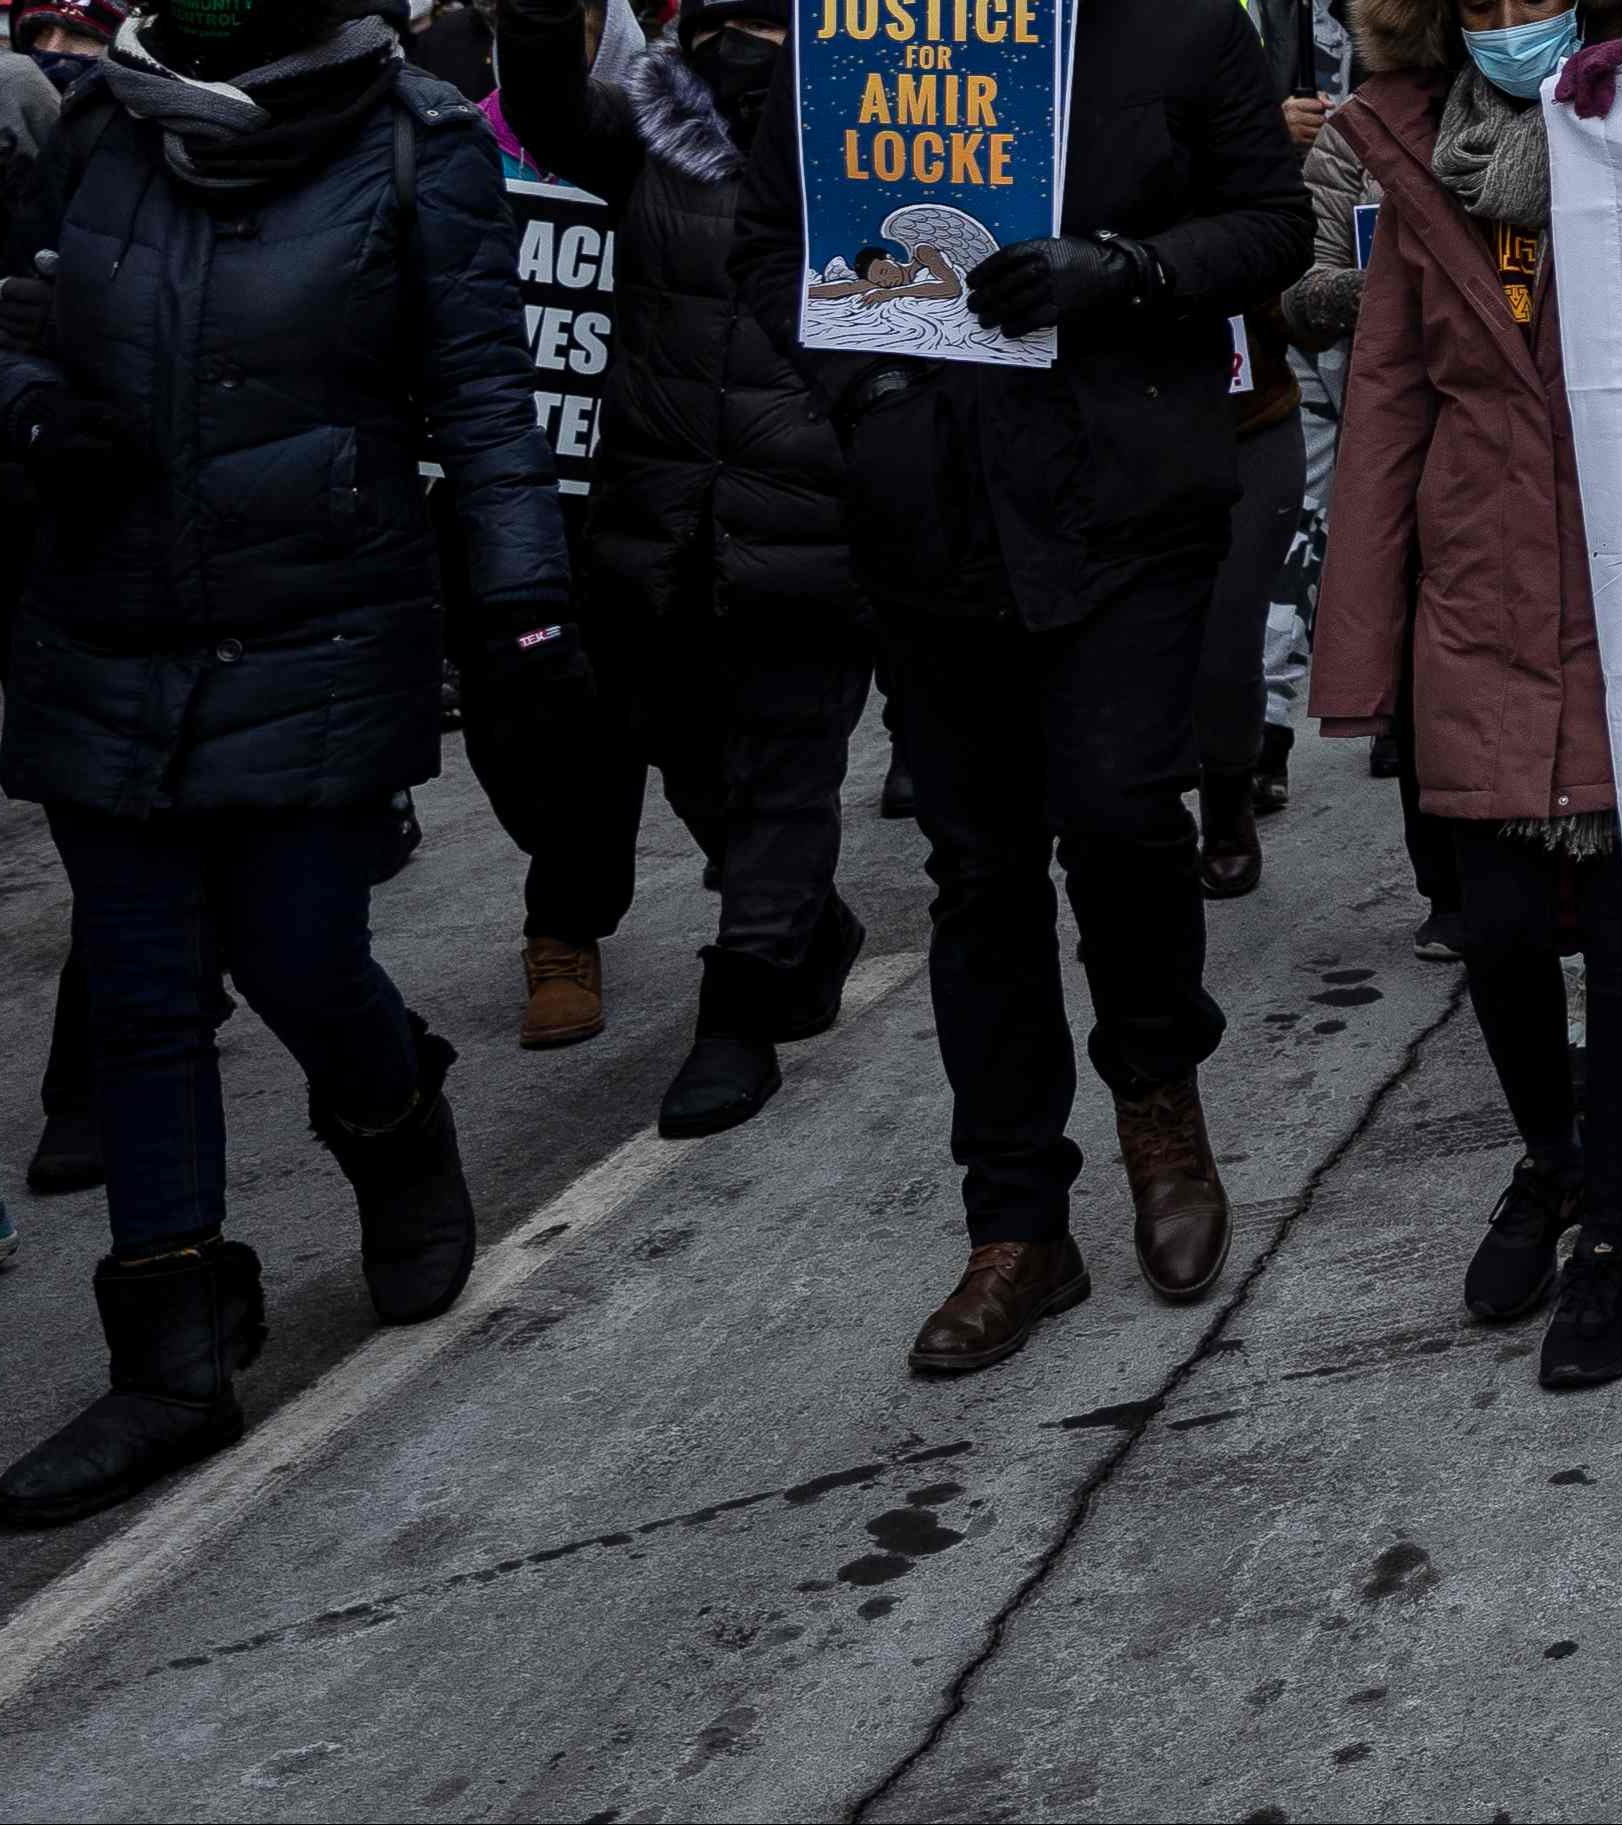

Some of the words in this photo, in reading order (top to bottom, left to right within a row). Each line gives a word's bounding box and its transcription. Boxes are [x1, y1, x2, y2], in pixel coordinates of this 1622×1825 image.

[905, 45, 952, 71] FOR
[858, 72, 999, 128] AMIR
[844, 128, 1015, 187] LOCKE
